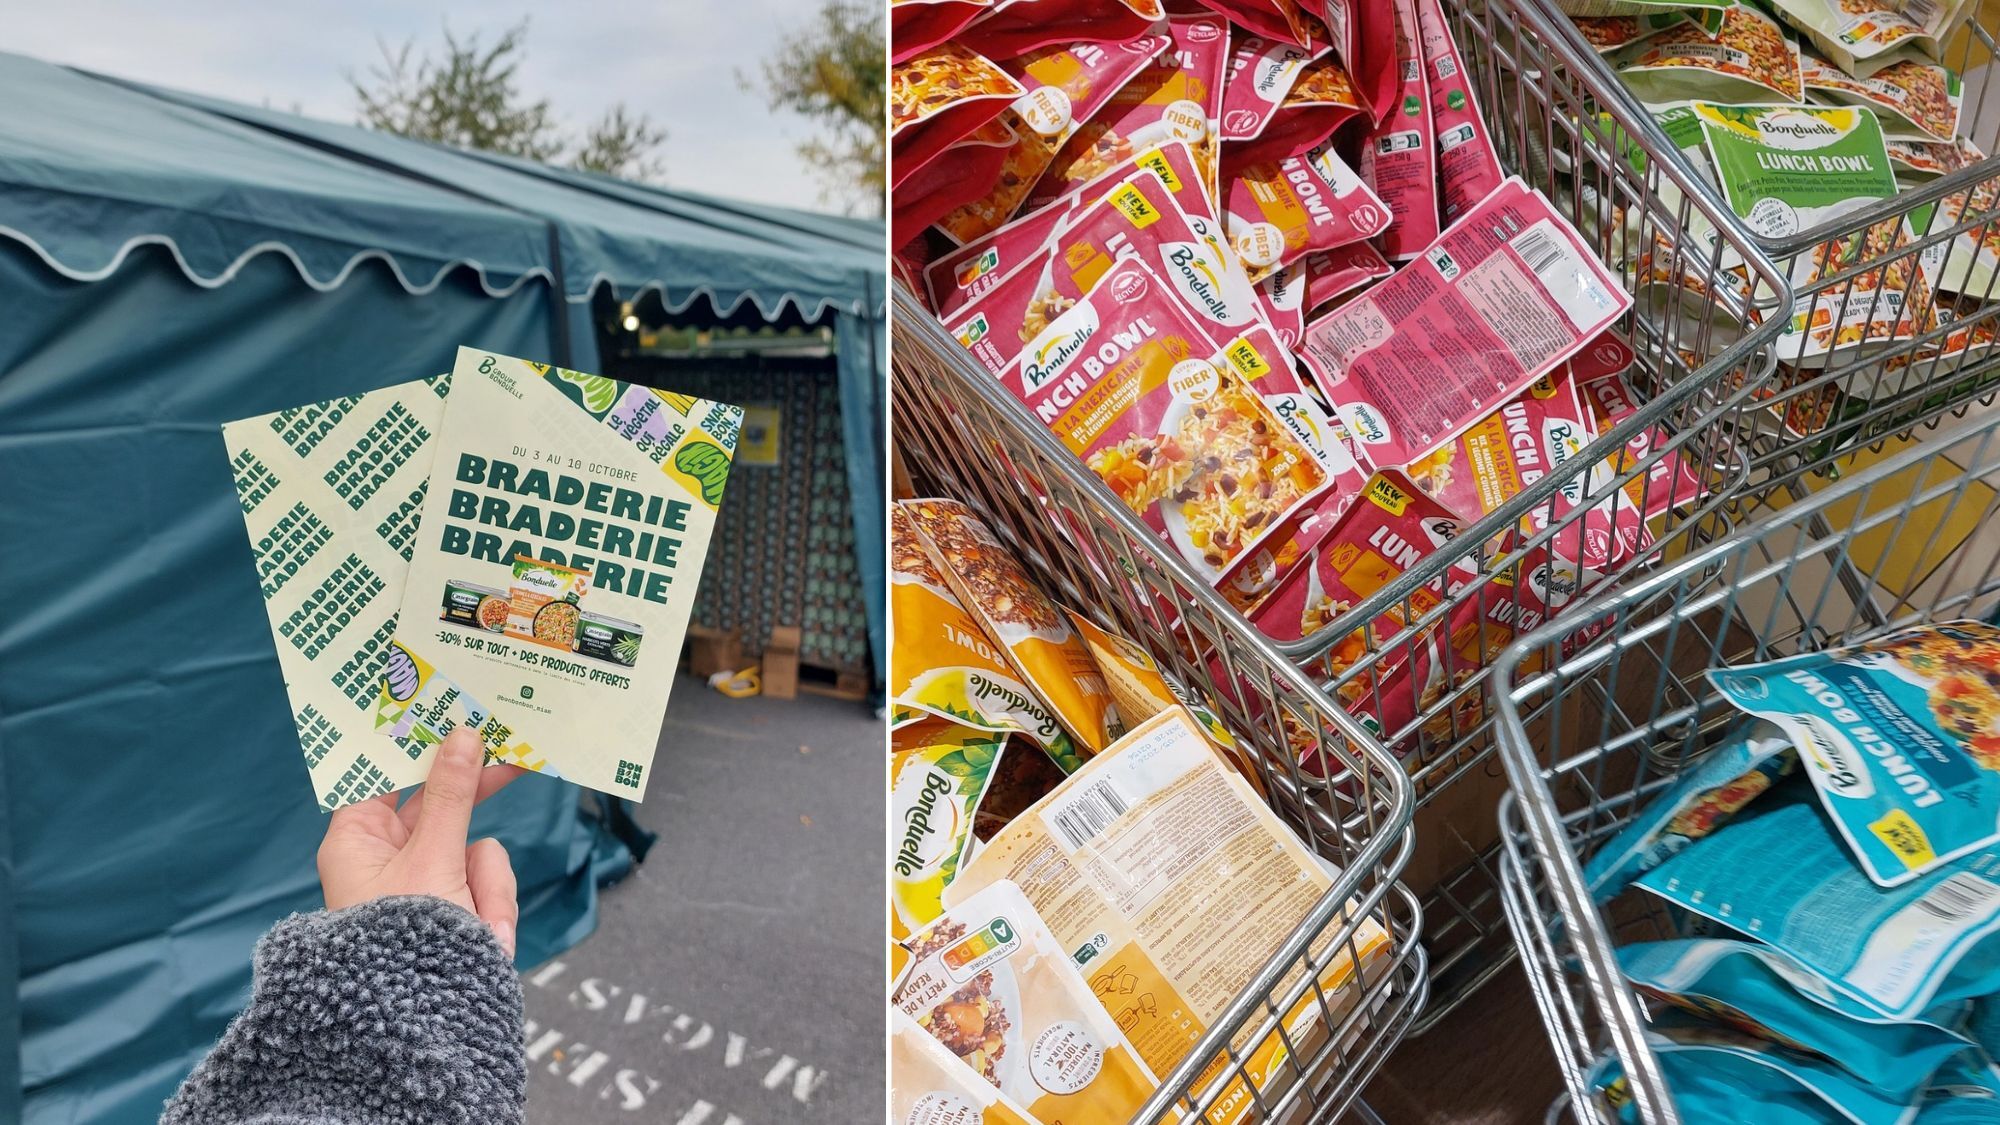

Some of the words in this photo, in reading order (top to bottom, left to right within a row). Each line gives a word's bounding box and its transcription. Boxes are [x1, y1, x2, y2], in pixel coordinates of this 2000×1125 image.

[1033, 91, 1062, 125] FIBER
[1167, 110, 1202, 131] FIBER
[1759, 121, 1837, 138] Bonduelle
[1149, 157, 1174, 186] NEW
[1756, 152, 1816, 171] LUNCH
[1819, 155, 1873, 172] BOWL
[1124, 190, 1150, 217] NEW
[1288, 170, 1330, 227] BOWL
[1755, 207, 1783, 225] NATURELLE
[1764, 220, 1790, 235] NATURAL
[1253, 225, 1270, 261] FIBER
[1169, 244, 1228, 321] Bonduelle
[1025, 326, 1093, 388] Bonduelle
[1082, 318, 1156, 380] BOWL
[1236, 346, 1260, 369] NEW
[489, 374, 523, 399] BONDUELLE
[492, 368, 517, 386] GROUPE
[1064, 415, 1080, 431] LA
[1079, 357, 1145, 415] MEXICAINE
[1173, 369, 1210, 394] FIBER
[1084, 398, 1114, 424] HARICOTS
[1354, 405, 1383, 442] Bonduelle
[323, 401, 407, 487] BRADERIE
[1489, 432, 1501, 444] LA
[336, 413, 419, 499] BRADERIE
[348, 426, 431, 511] BRADERIE
[512, 446, 526, 457] DU
[533, 451, 539, 460] 3
[547, 454, 561, 465] AU
[568, 459, 581, 470] 10
[589, 463, 638, 482] OCTOBRE
[456, 452, 691, 532] BRADERIE
[1376, 479, 1404, 501] NEW
[448, 489, 682, 569] BRADERIE
[440, 524, 673, 605] BRADERIE
[521, 573, 557, 588] Bonduelle
[278, 553, 363, 638] BRADERIE
[291, 565, 375, 650] BRADERIE
[303, 576, 387, 661] BRADERIE
[435, 631, 461, 646] -30%
[464, 636, 483, 651] SUR
[487, 641, 510, 658] TOUT
[496, 694, 552, 714] @bonbonbon_miam
[970, 673, 1056, 737] Bonduelle
[1783, 669, 1863, 724] BOWL
[614, 776, 638, 788] BON
[619, 760, 643, 773] BON
[1852, 726, 1944, 808] LUNCH
[894, 771, 952, 879] Bonduelle
[994, 923, 1008, 938] A
[970, 941, 1017, 972] NUTRI-SCORE
[908, 972, 932, 994] READY
[925, 978, 948, 1003] PRÊT
[1043, 1030, 1076, 1066] NATURAL
[1059, 1042, 1093, 1082] NATURELLE
